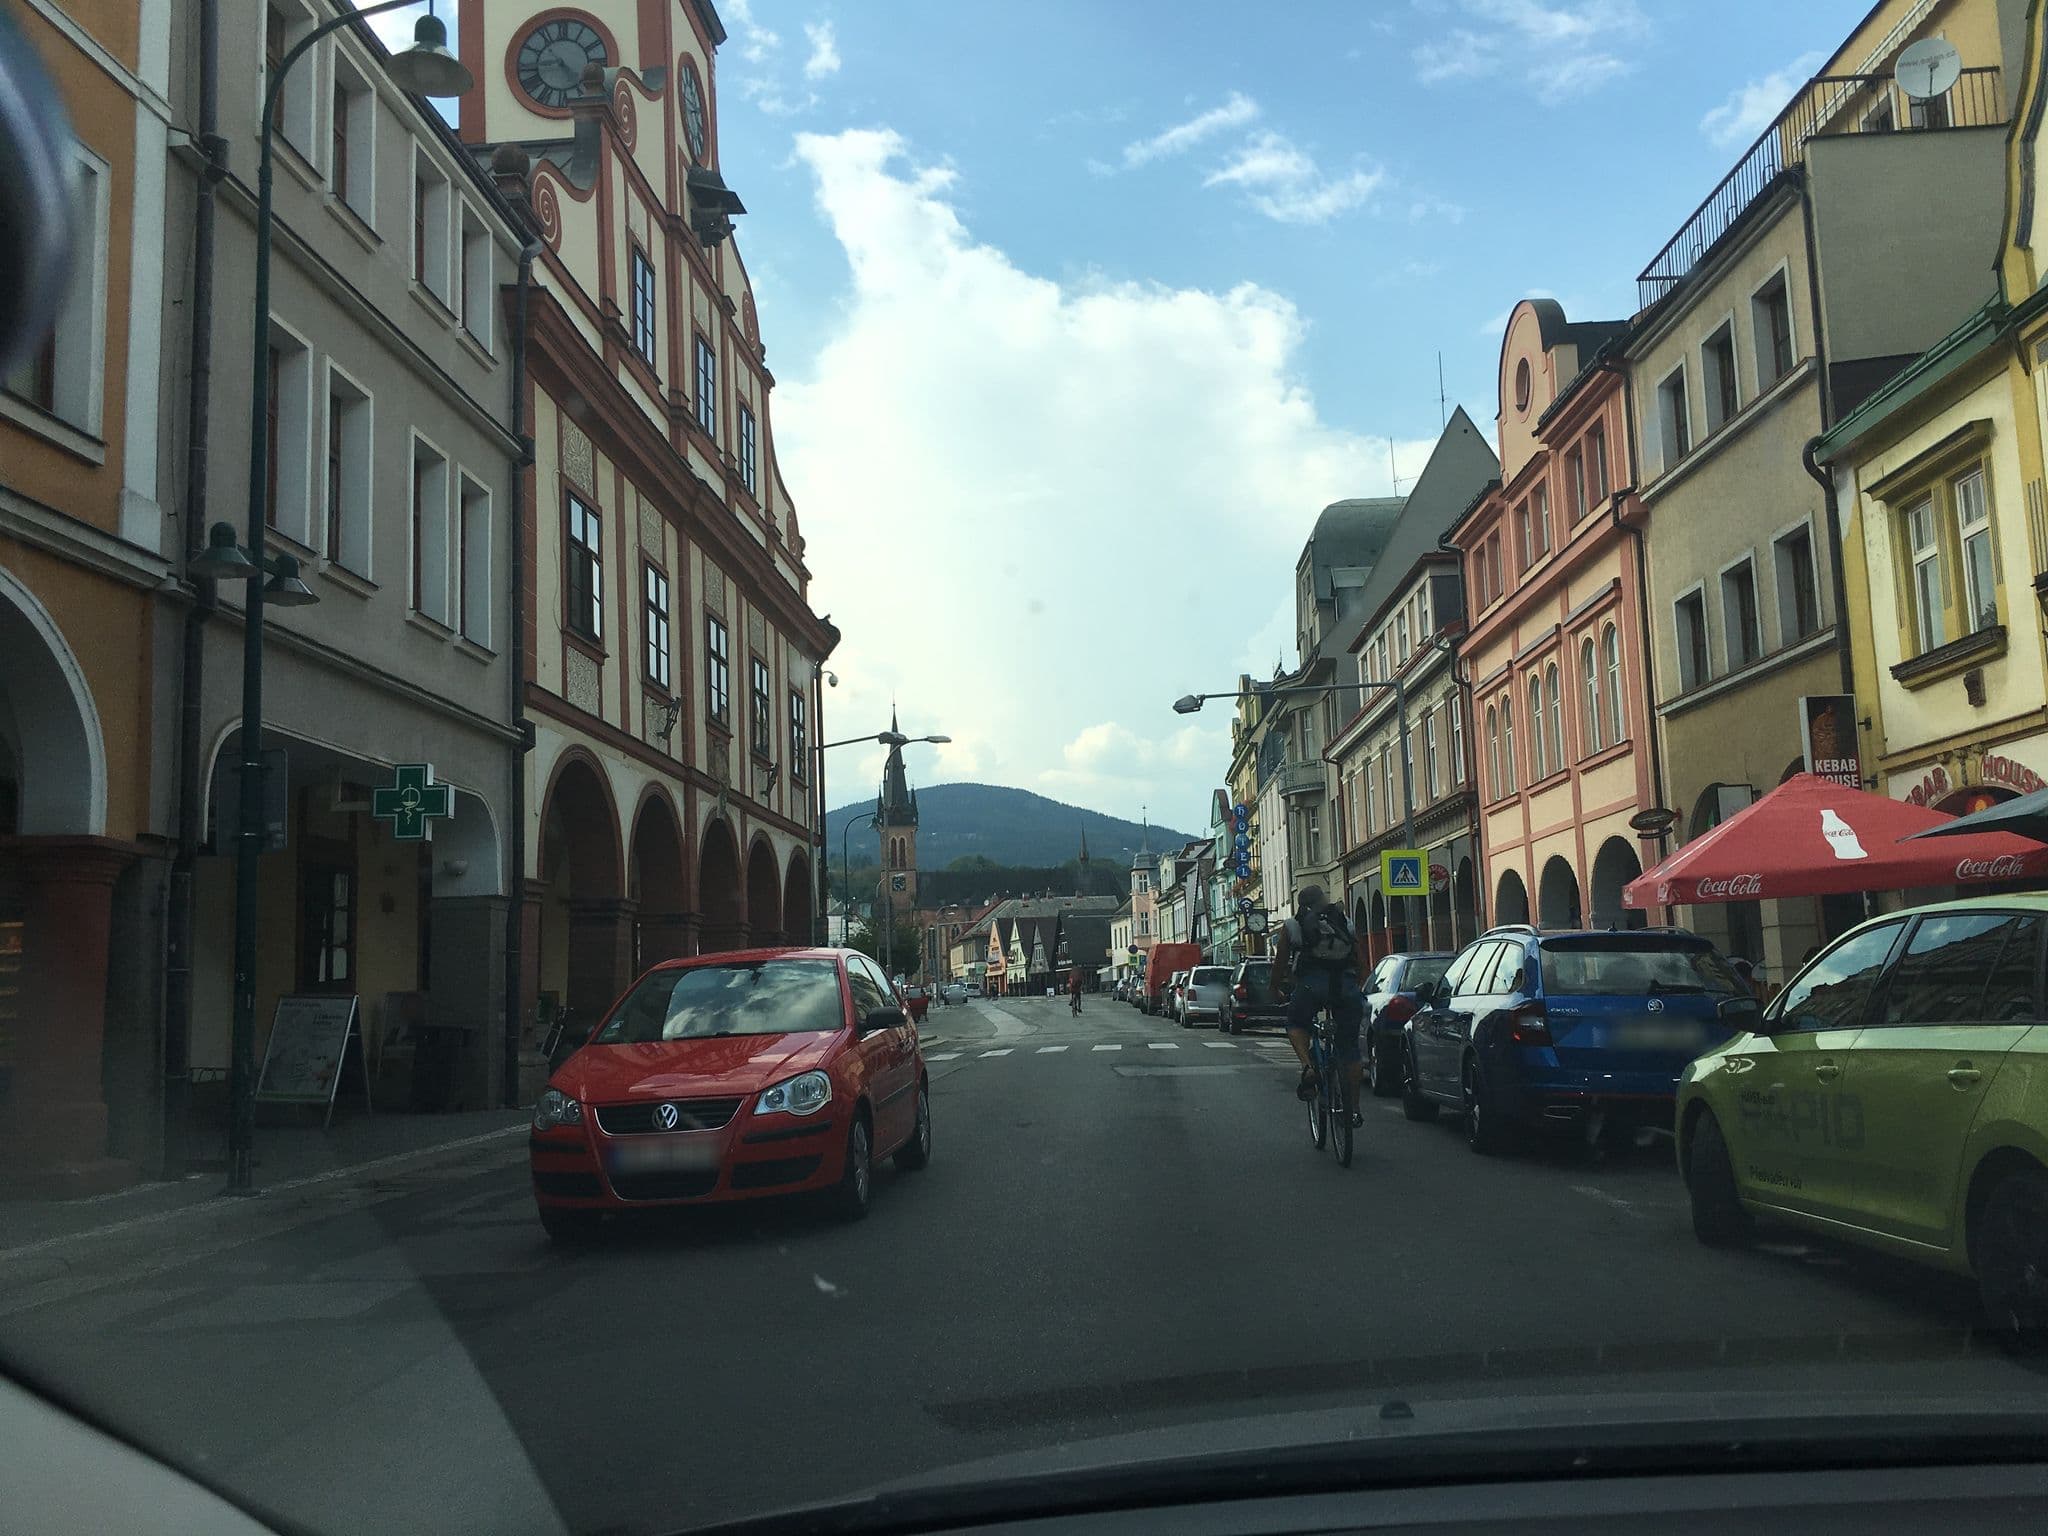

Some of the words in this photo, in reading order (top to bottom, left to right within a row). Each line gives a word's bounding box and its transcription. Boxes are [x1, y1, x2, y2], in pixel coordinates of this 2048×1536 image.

[1815, 758, 1857, 773] KEBAB
[1905, 767, 1949, 806] BAB
[1955, 854, 2026, 880] Coca-Cola
[1696, 873, 1763, 899] Coca-Cola
